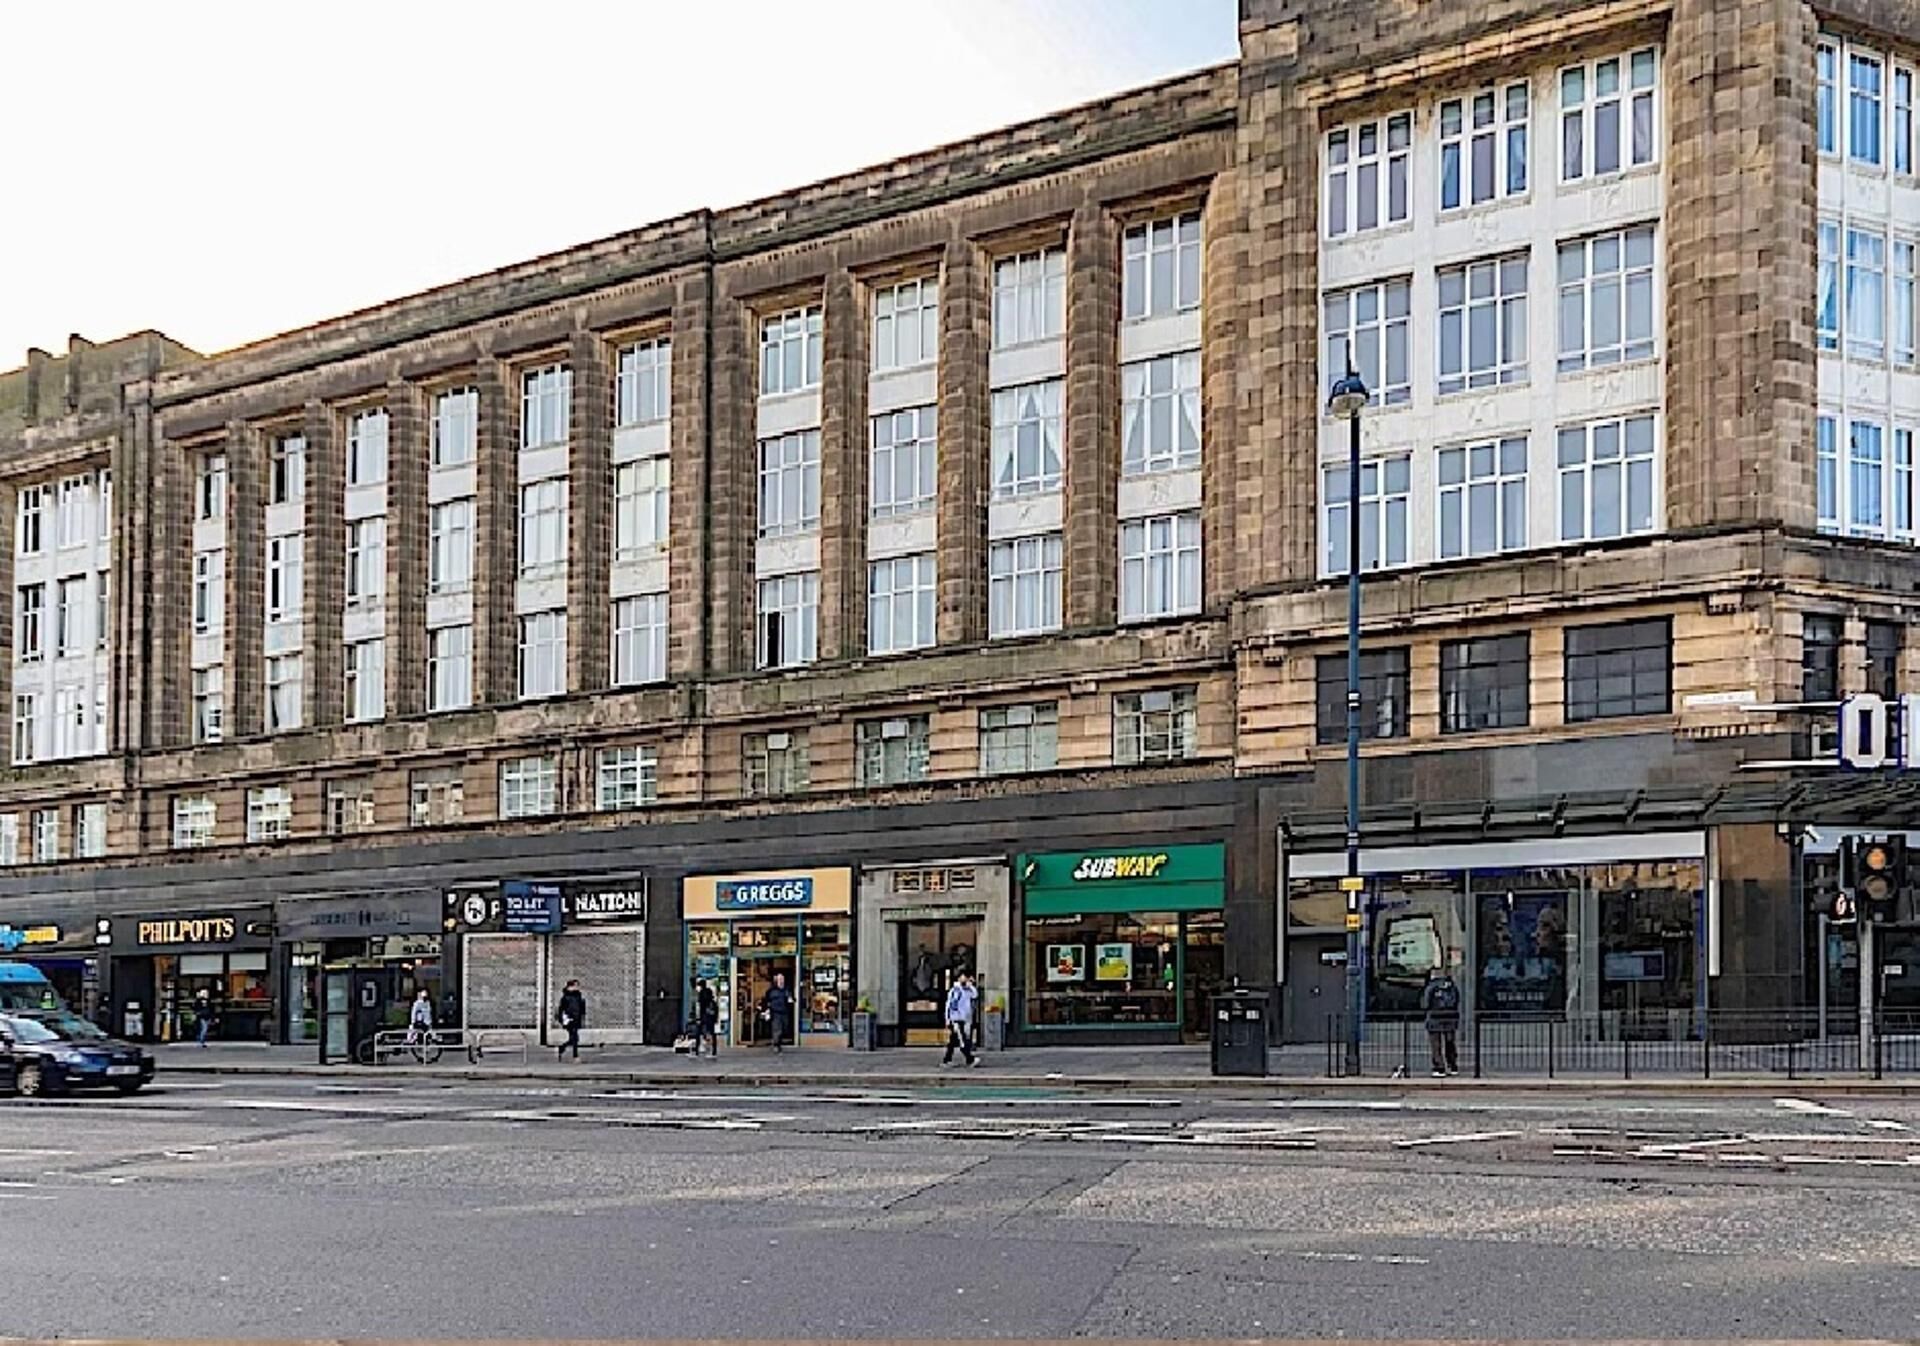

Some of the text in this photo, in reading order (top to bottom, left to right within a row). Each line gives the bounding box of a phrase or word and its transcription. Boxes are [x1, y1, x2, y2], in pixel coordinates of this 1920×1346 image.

[1074, 855, 1167, 878] SUBWAY
[575, 891, 641, 911] NATION
[737, 882, 803, 902] GREGGS
[138, 918, 234, 943] PHILPOTTS
